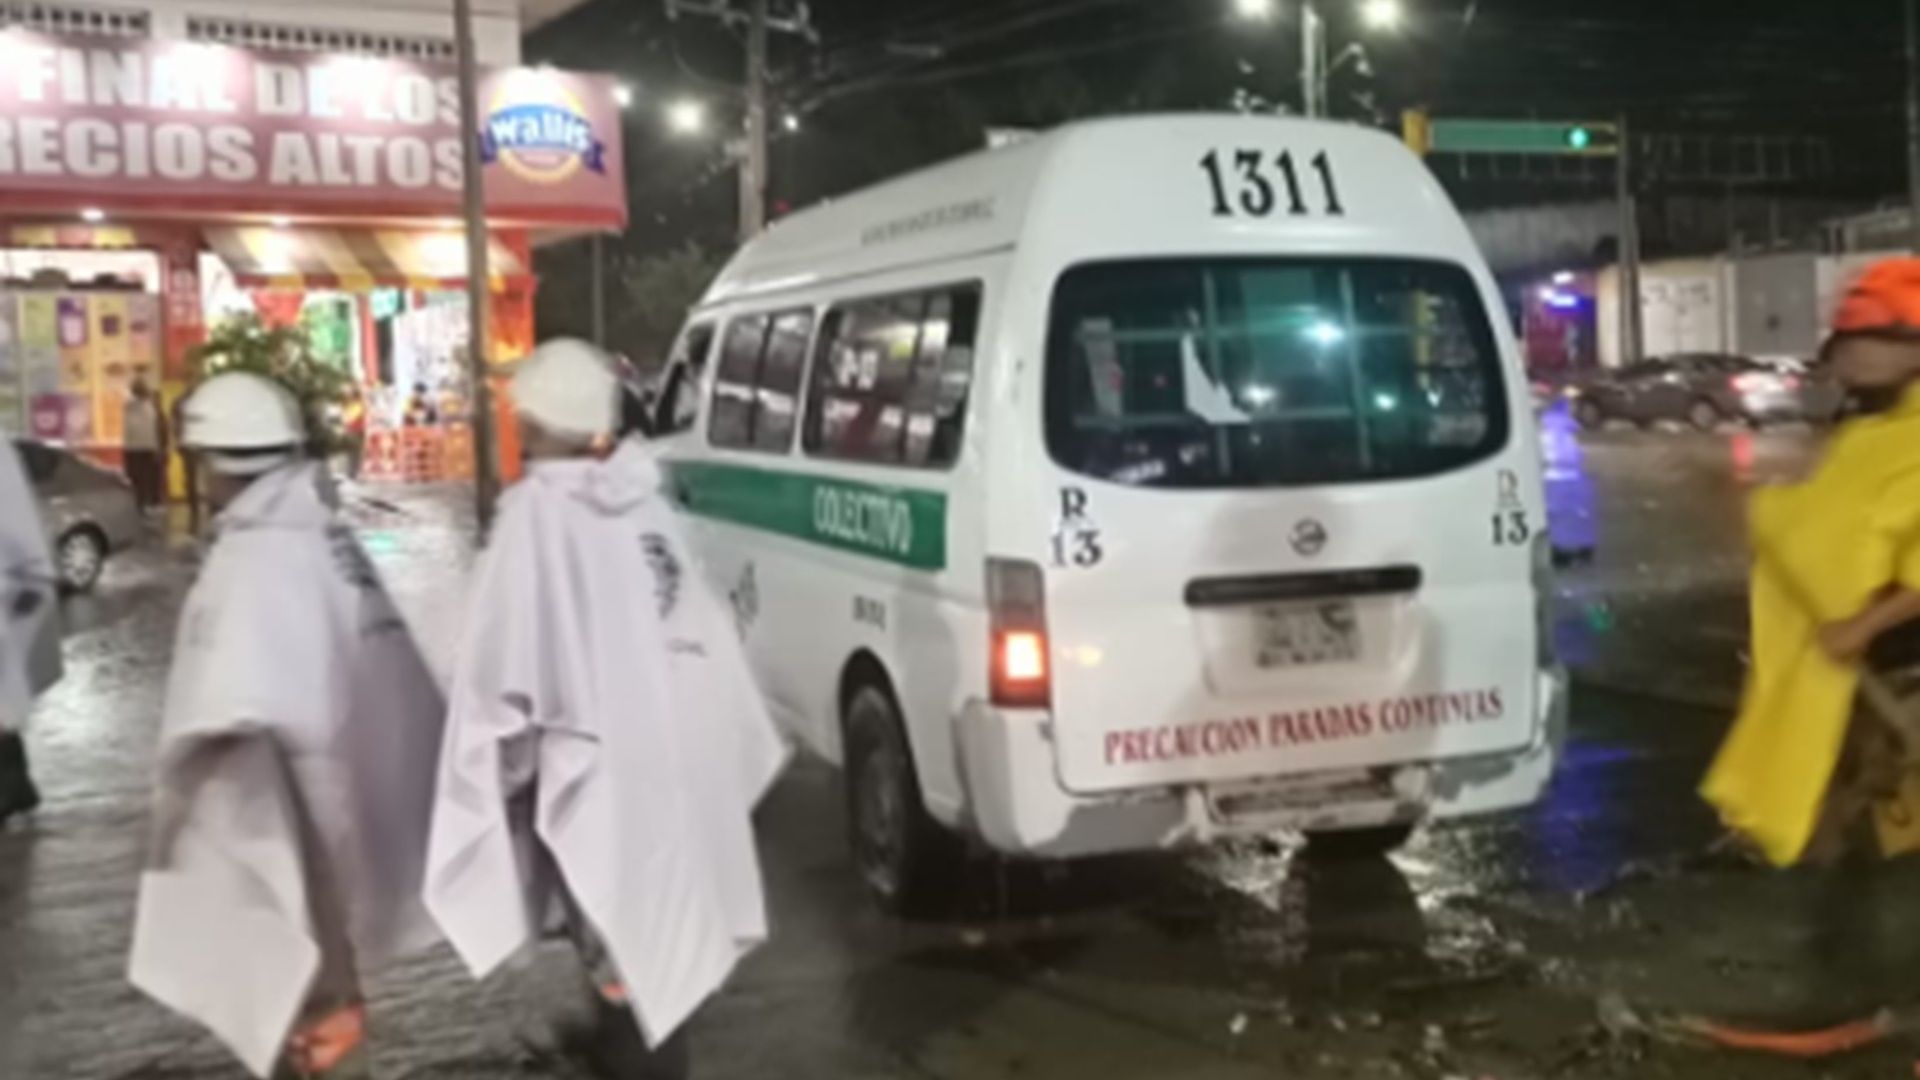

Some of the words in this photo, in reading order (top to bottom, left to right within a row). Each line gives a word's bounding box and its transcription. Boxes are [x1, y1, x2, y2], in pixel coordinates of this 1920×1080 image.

[20, 44, 236, 111] FINAL
[254, 62, 343, 117] DE
[358, 64, 460, 125] LOS
[269, 132, 463, 189] ALTOS
[1199, 149, 1345, 217] 1311
[1060, 486, 1089, 522] R
[1498, 468, 1521, 508] R
[813, 484, 912, 555] COLECTIVO
[1491, 511, 1529, 546] 13
[1049, 530, 1102, 567] 13
[1105, 714, 1260, 765] PRECAUCION
[1270, 701, 1373, 747] PARADAS
